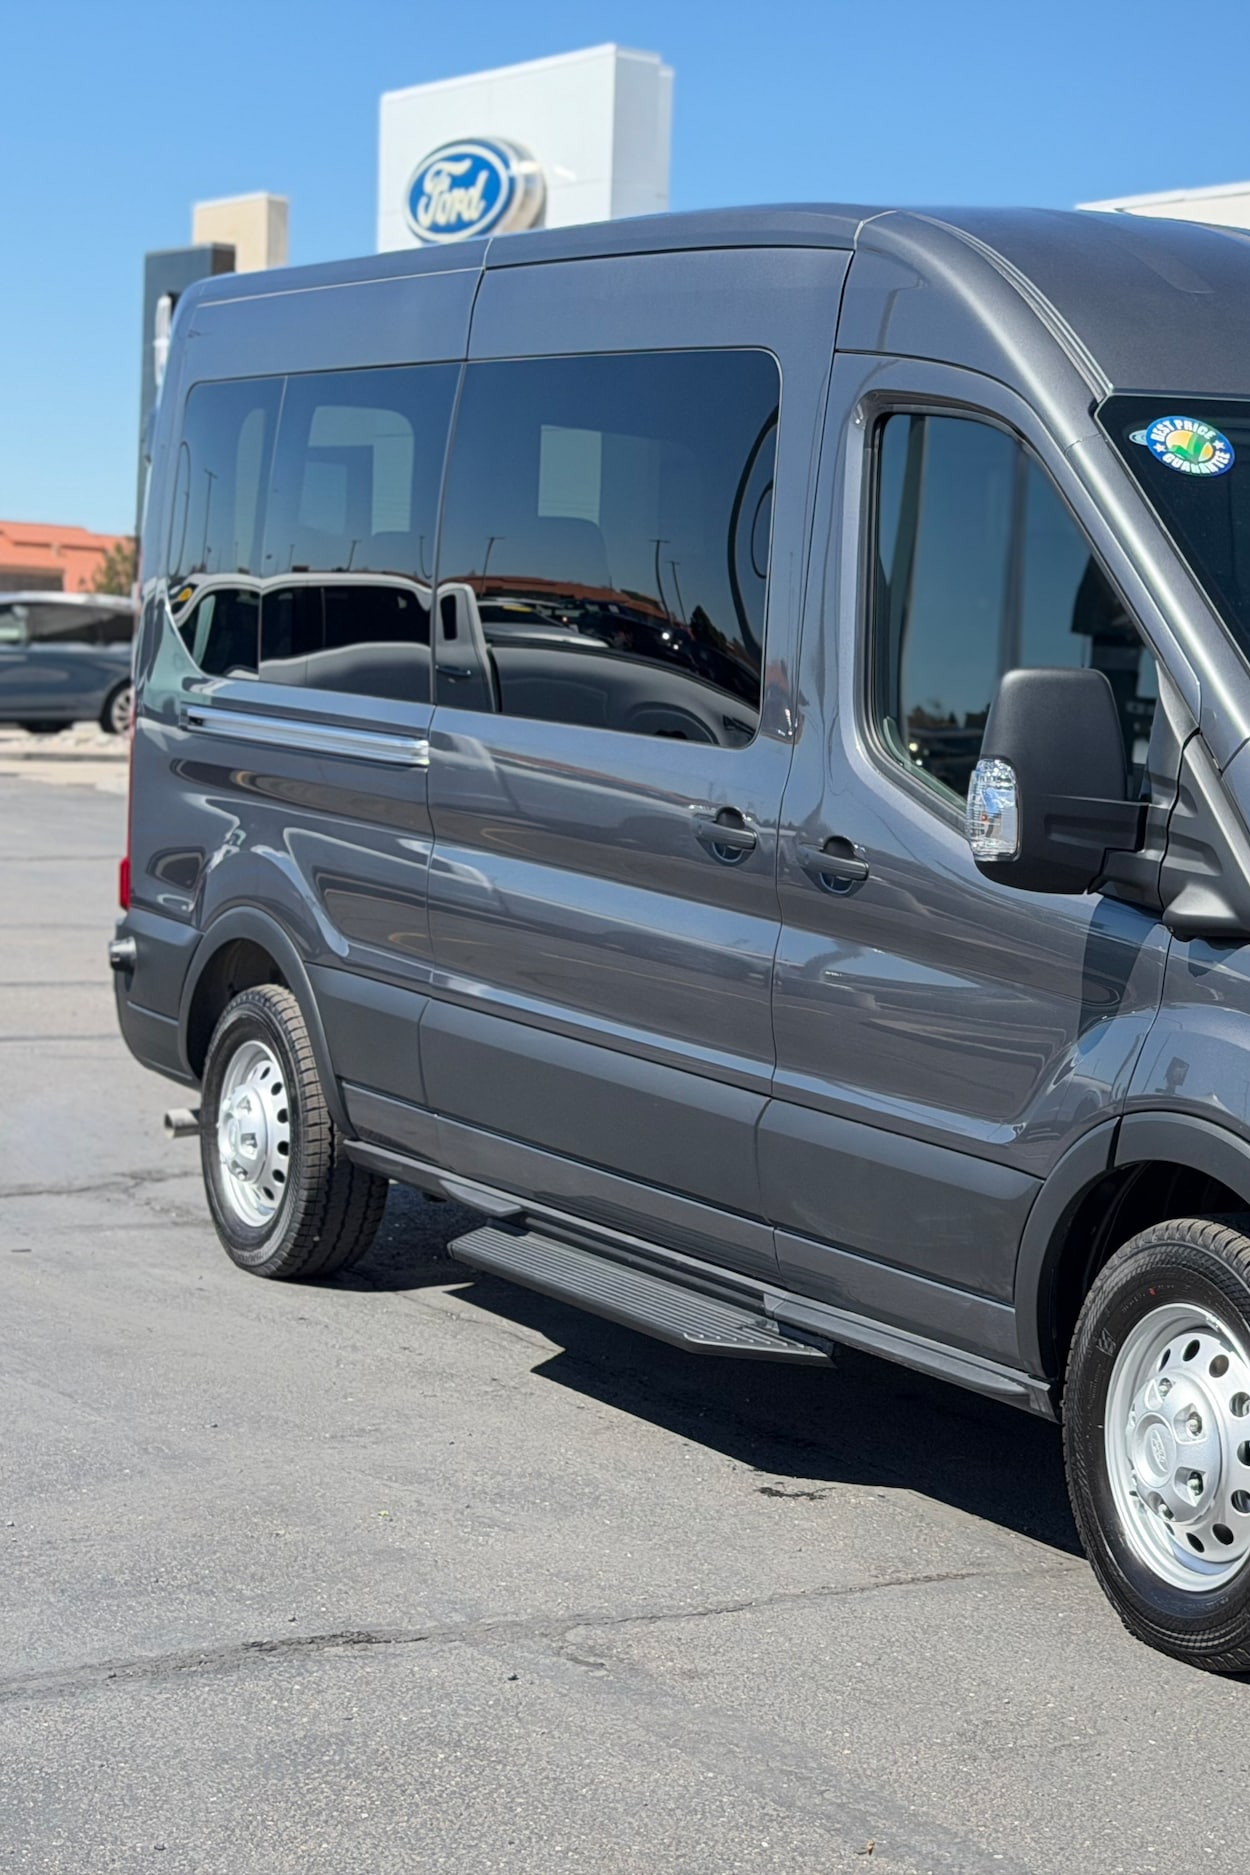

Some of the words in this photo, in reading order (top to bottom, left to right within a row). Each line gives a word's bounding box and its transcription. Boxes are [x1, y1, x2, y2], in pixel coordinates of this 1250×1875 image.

[417, 157, 489, 229] Ford
[1150, 420, 1175, 442] BEST
[1173, 419, 1217, 440] PRICE
[1162, 450, 1231, 474] GUARANTEE
